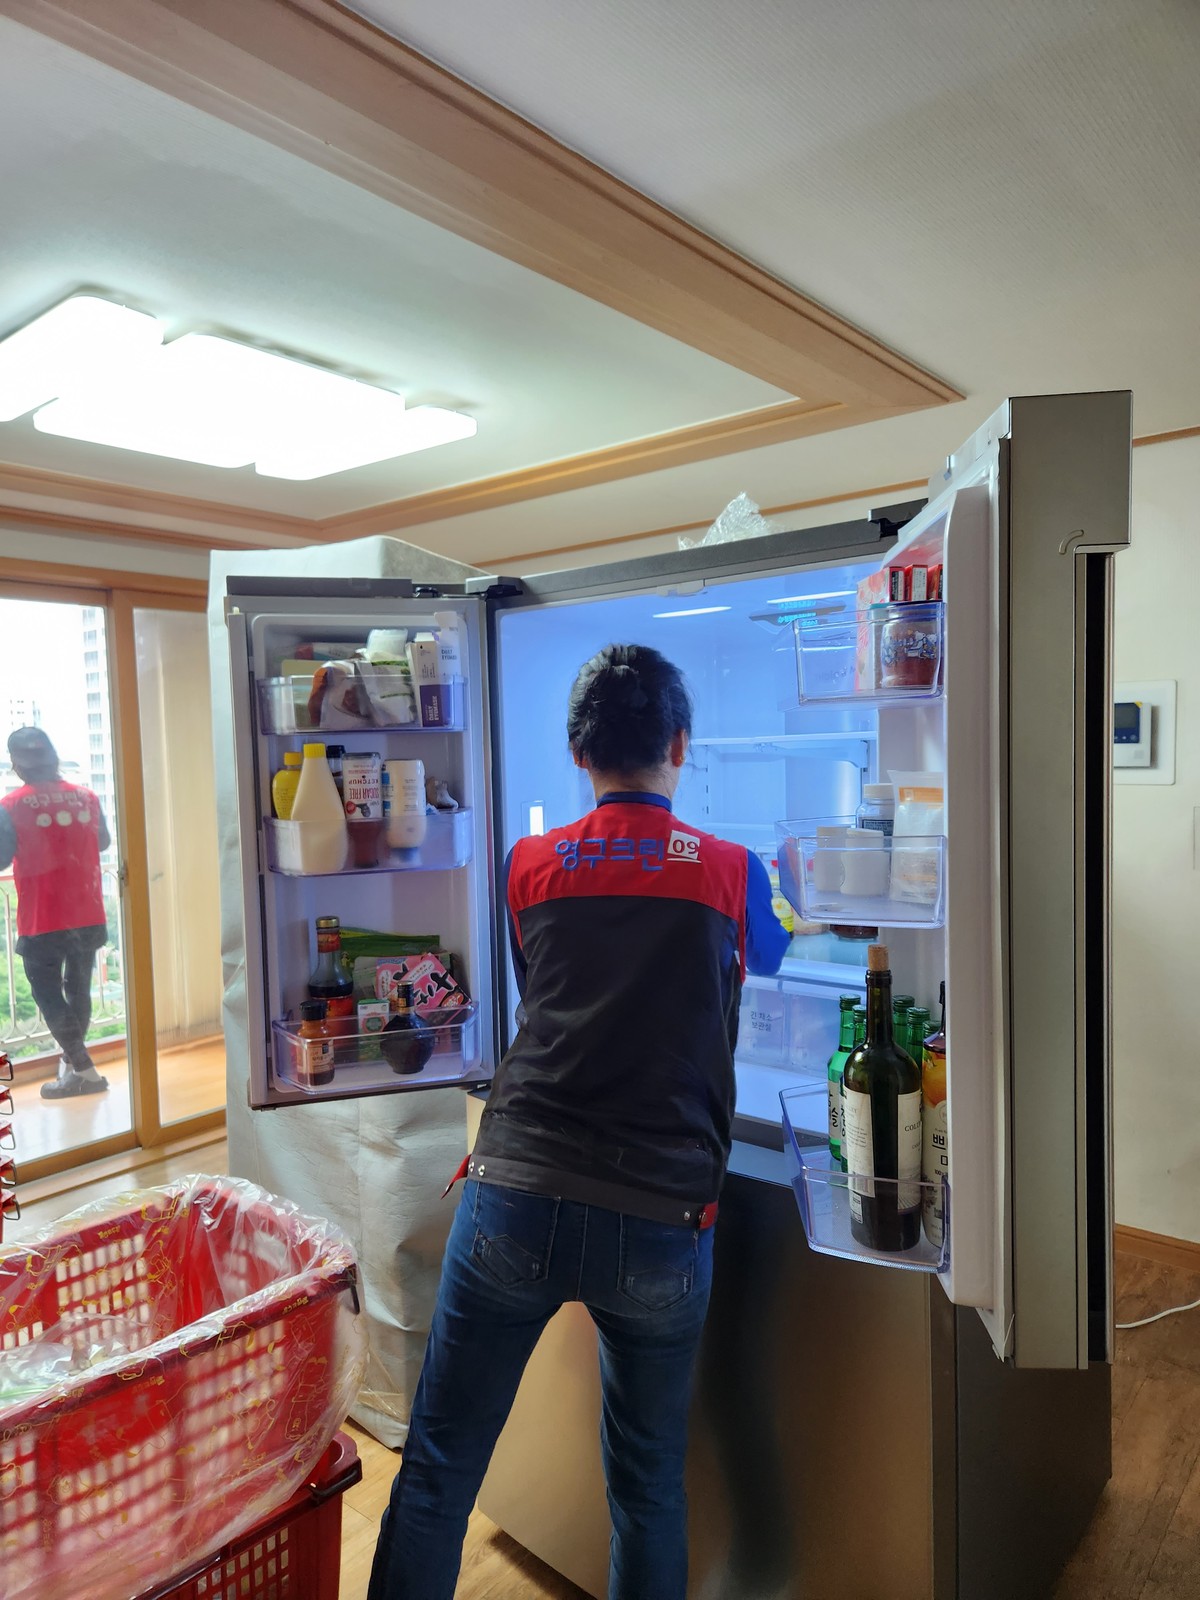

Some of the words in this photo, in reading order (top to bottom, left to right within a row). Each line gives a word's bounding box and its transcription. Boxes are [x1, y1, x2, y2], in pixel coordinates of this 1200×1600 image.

[22, 791, 84, 809] 영구크린
[348, 787, 362, 800] FREE
[362, 787, 380, 800] SUGAR
[555, 838, 664, 871] 영구크린
[672, 839, 699, 855] 09
[750, 1010, 757, 1020] 긴
[751, 1021, 771, 1032] 보관실
